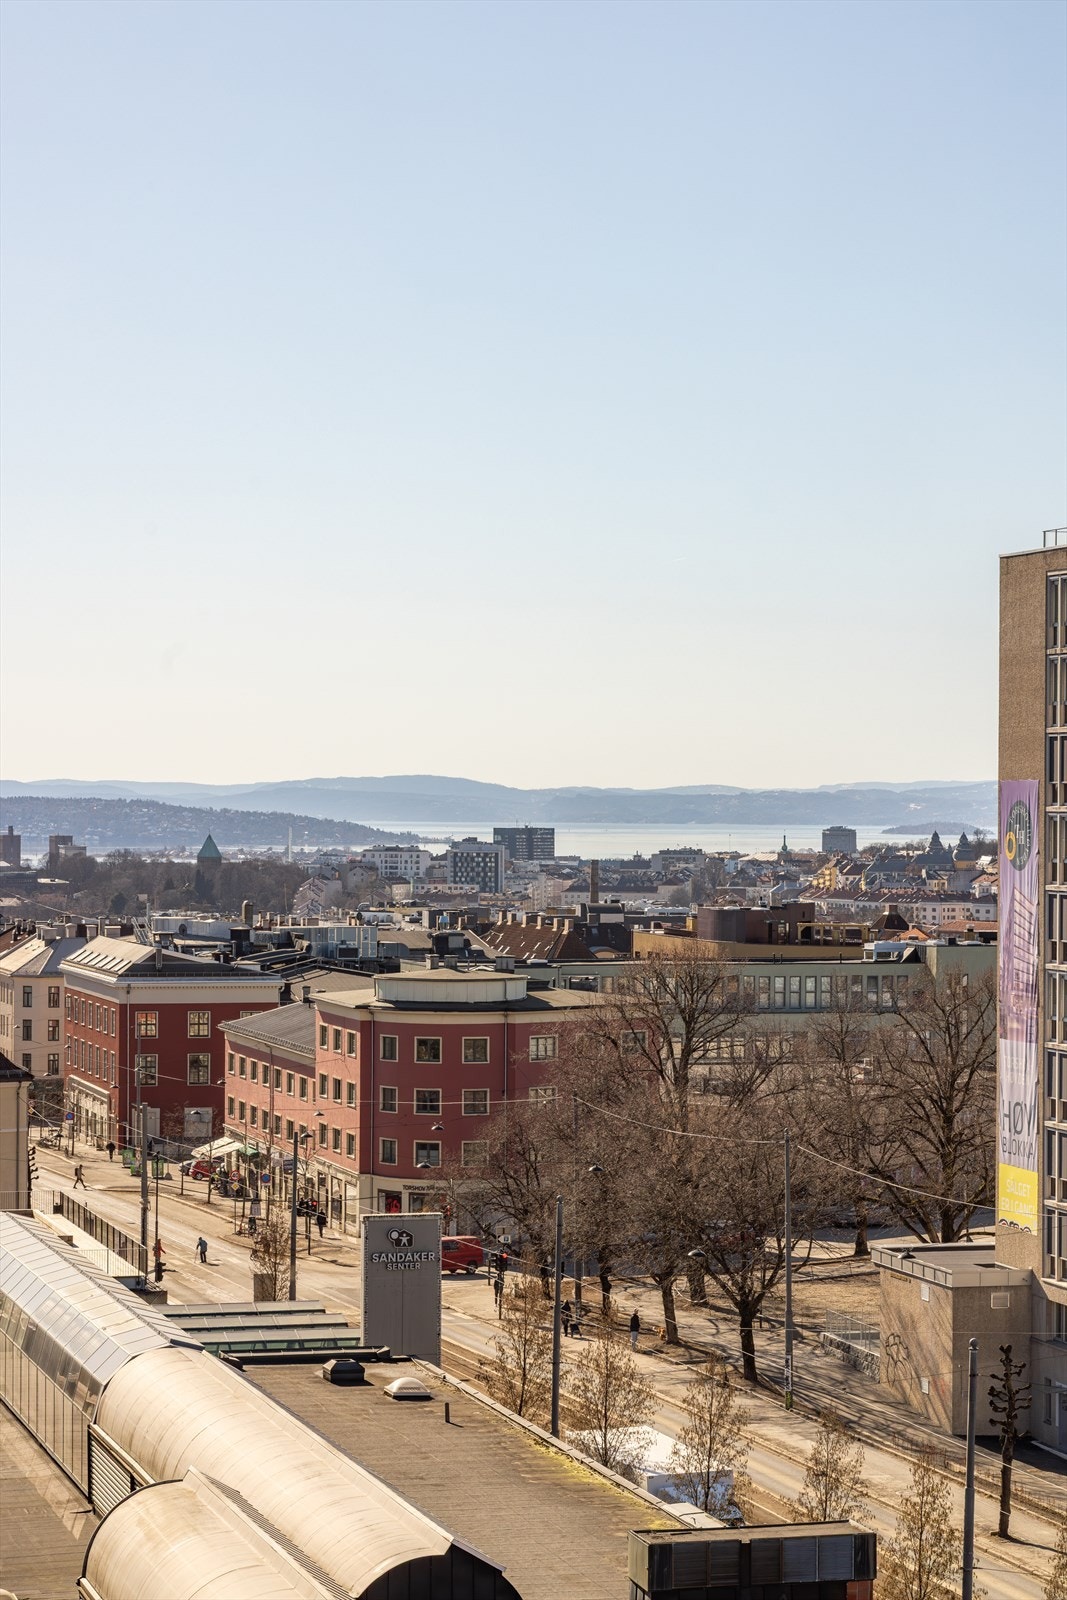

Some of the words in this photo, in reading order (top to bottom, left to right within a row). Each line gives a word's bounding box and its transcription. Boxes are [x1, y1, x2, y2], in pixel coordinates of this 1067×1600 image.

[1002, 1136, 1035, 1160] BLOKKA
[372, 1252, 435, 1263] SANDAKER
[387, 1262, 421, 1271] SENTER
